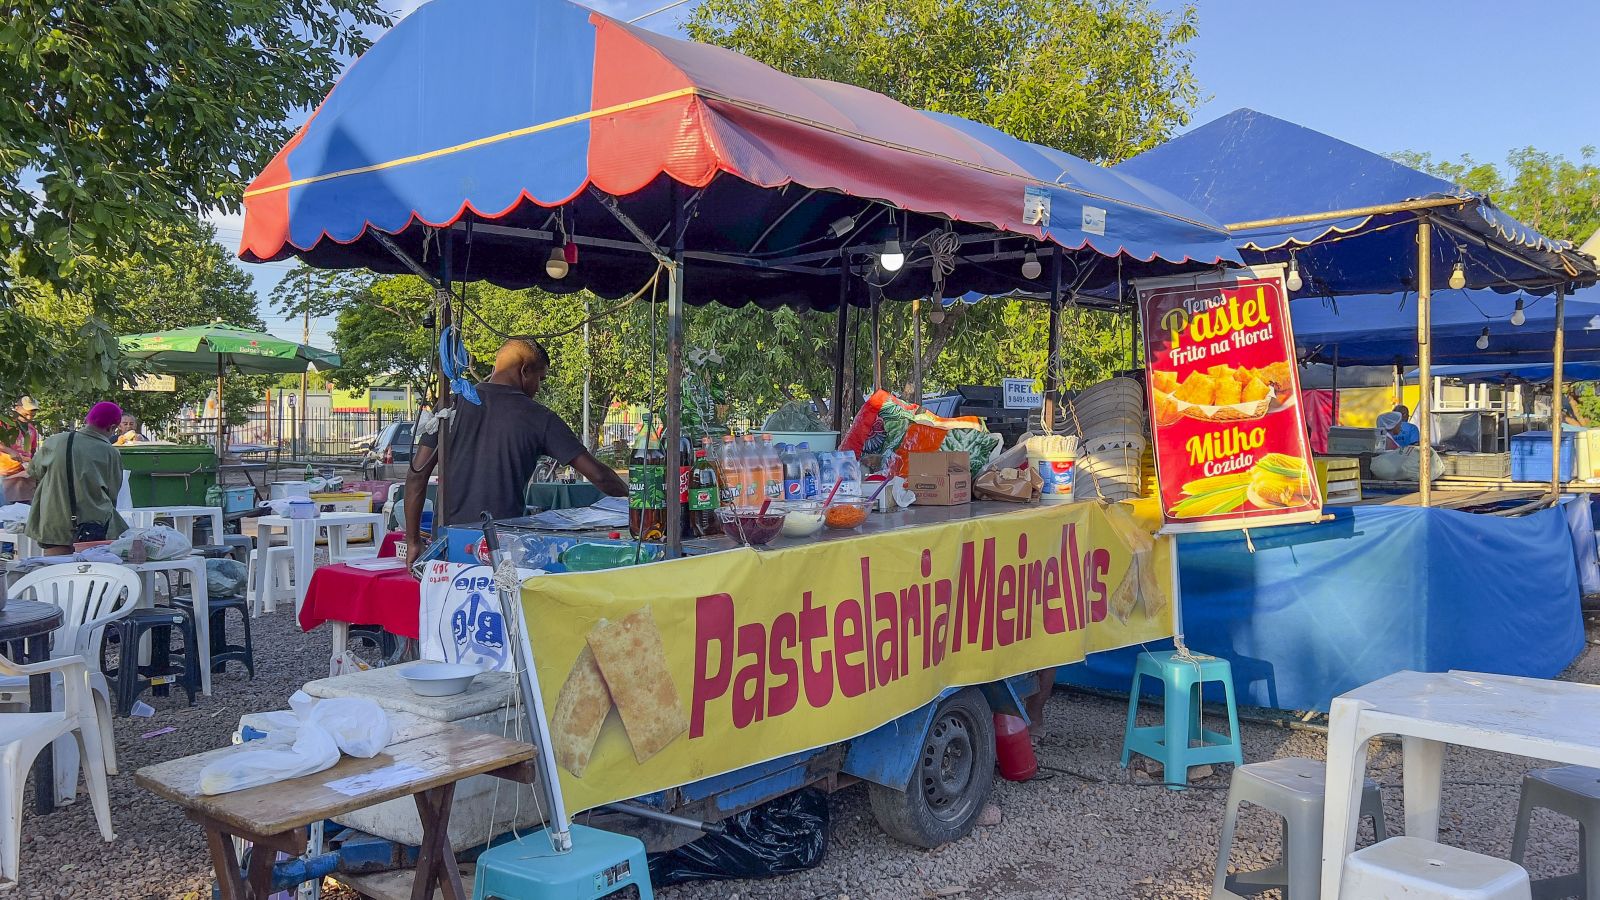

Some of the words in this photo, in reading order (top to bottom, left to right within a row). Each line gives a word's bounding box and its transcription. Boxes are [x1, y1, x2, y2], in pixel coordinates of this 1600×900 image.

[1161, 286, 1271, 350] Pastel
[1183, 293, 1227, 315] Temos
[1169, 344, 1208, 367] Frito
[1210, 339, 1230, 354] na
[1231, 325, 1274, 349] Hora!
[1186, 427, 1266, 466] Milho
[1203, 454, 1254, 478] Cozido
[688, 548, 953, 740] Pastelaria
